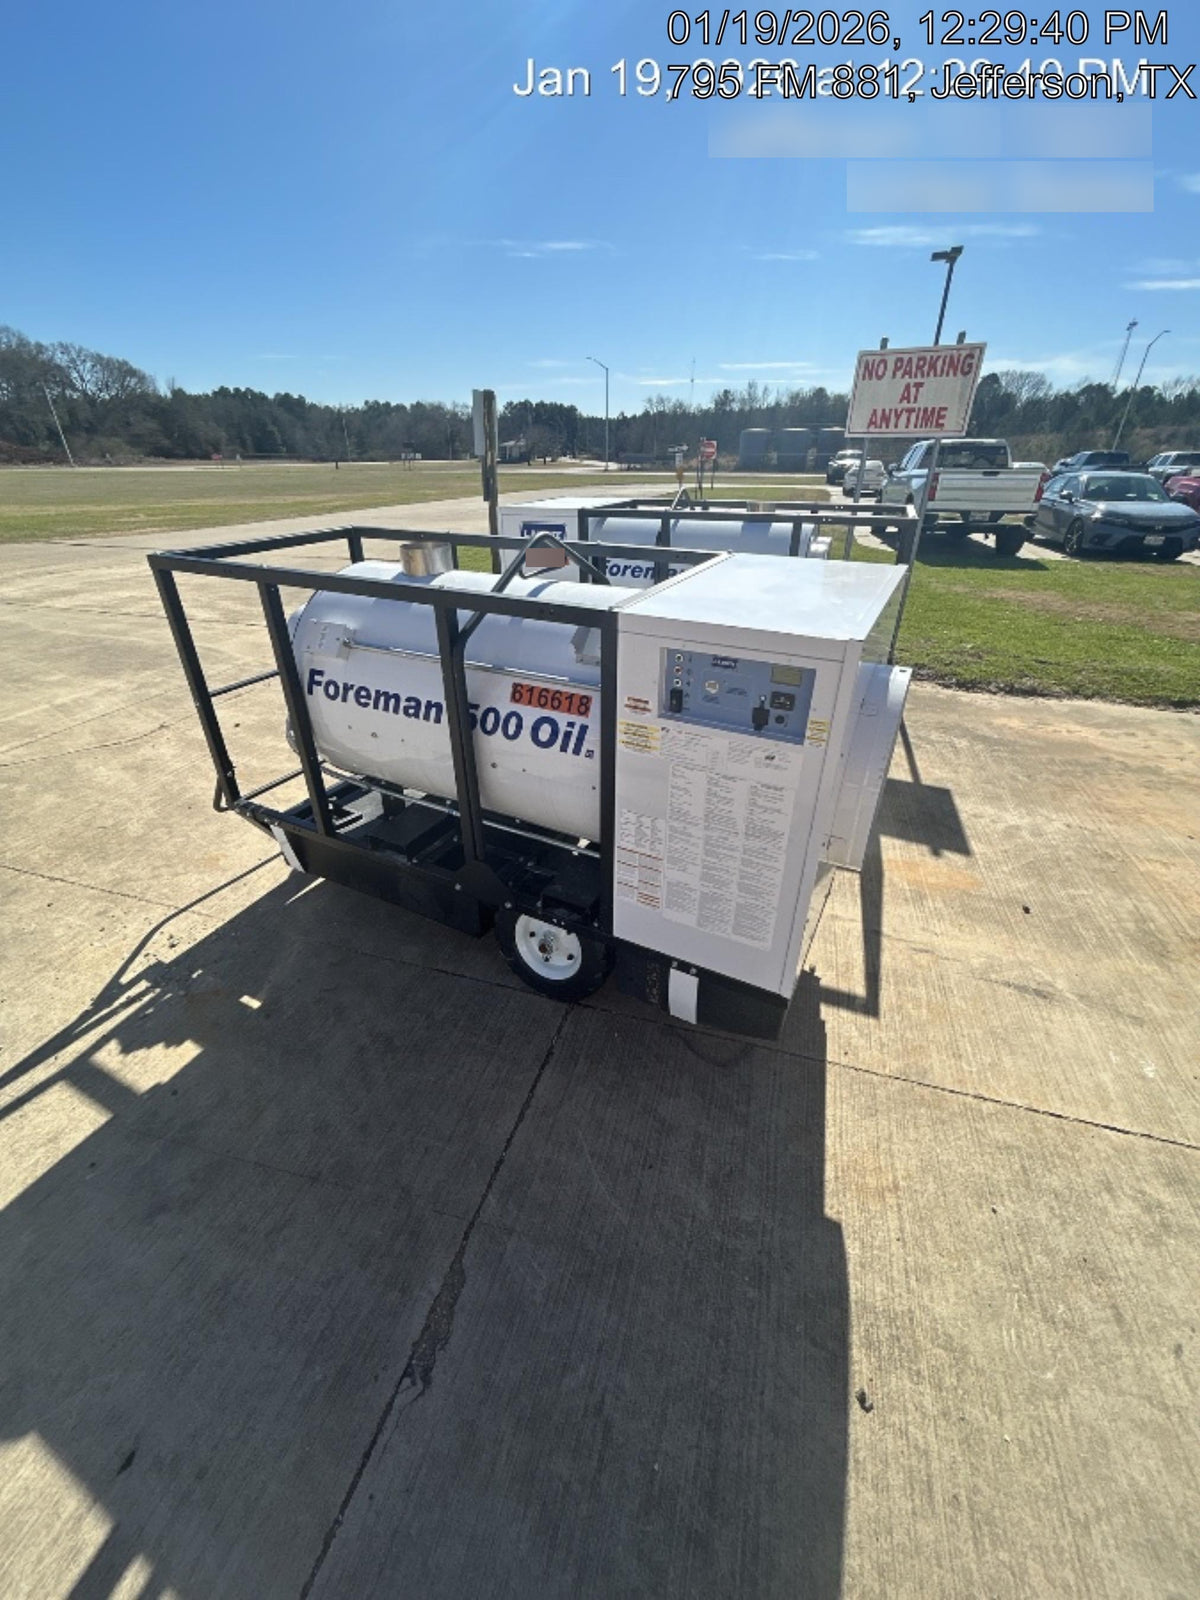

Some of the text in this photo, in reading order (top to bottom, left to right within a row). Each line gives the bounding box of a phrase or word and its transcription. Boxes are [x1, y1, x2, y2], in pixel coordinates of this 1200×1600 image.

[862, 352, 976, 381] NO PARKING
[899, 382, 925, 404] AT
[867, 407, 948, 429] ANYTIME
[307, 668, 444, 724] Foreman
[530, 716, 589, 756] Oil
[511, 683, 590, 715] 616618
